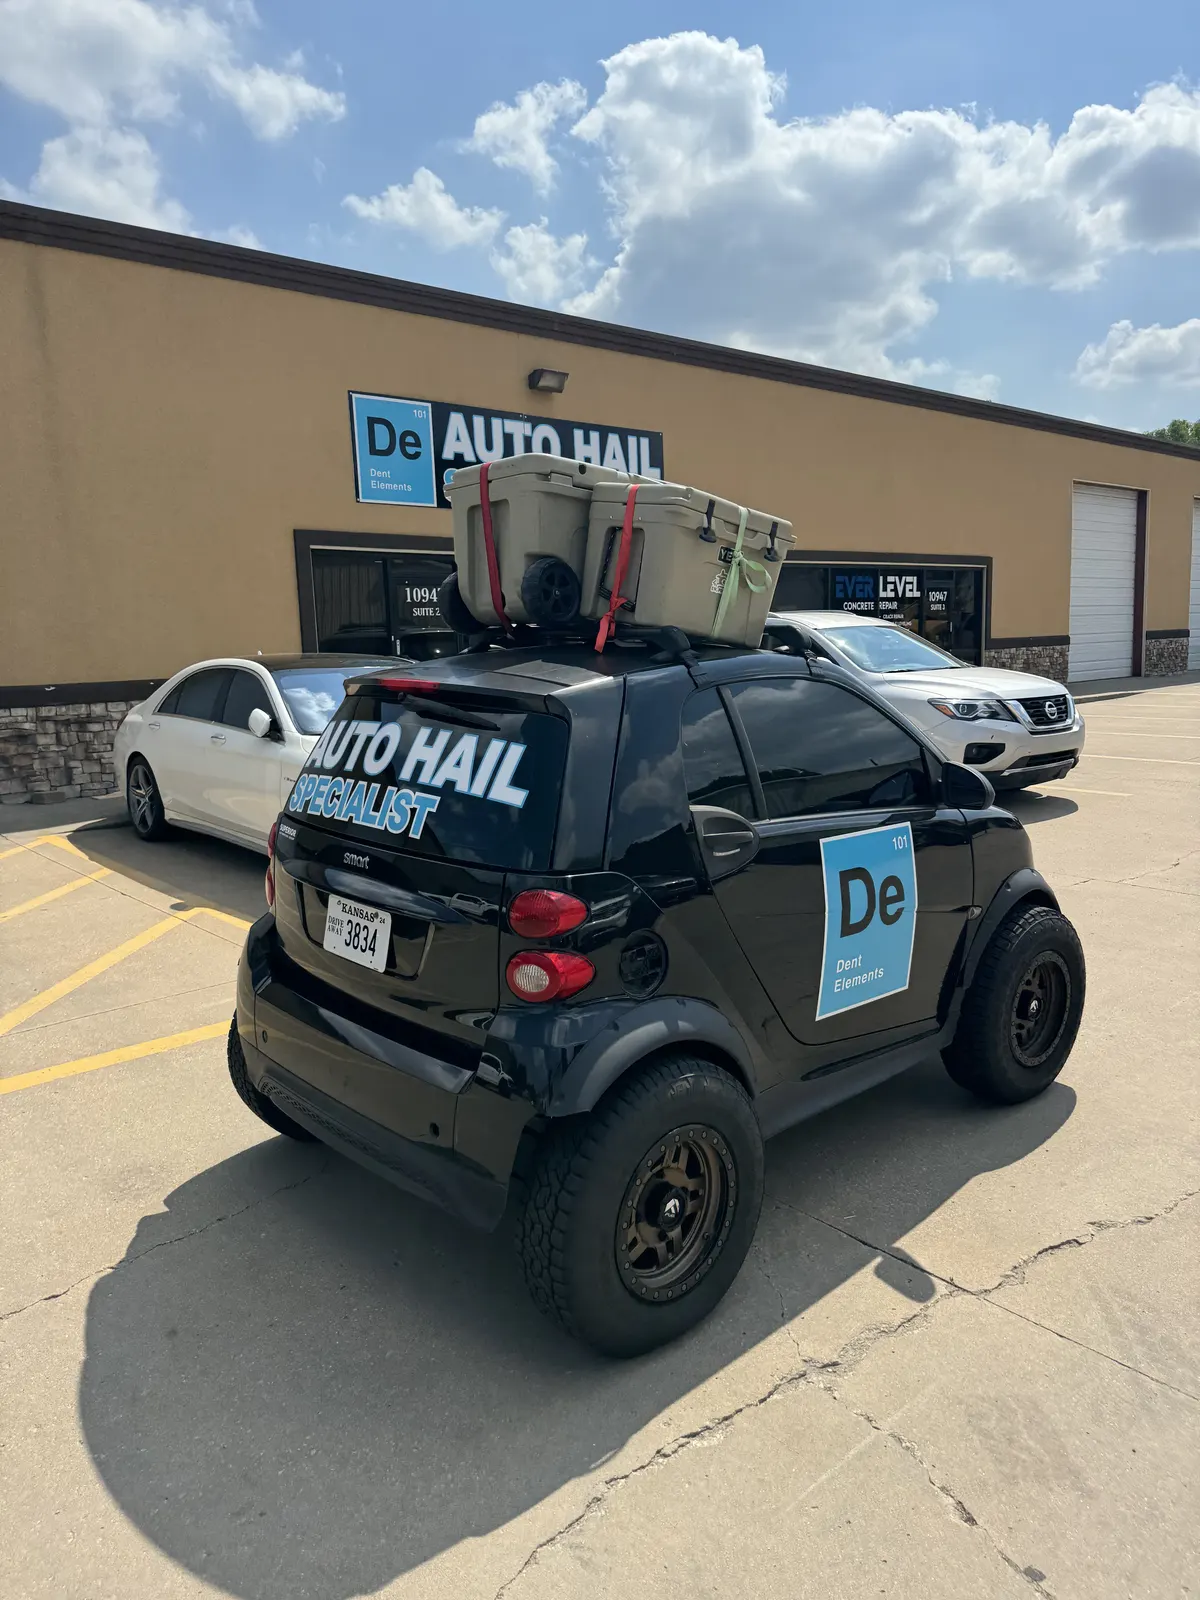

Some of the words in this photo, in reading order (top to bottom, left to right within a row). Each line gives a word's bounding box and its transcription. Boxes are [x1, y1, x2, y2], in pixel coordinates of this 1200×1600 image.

[413, 409, 427, 419] 101
[367, 416, 422, 460] De
[442, 412, 561, 463] AUTO
[573, 428, 661, 480] HAIL
[370, 468, 391, 479] Dent
[371, 481, 412, 492] Elements
[405, 588, 441, 602] 1094
[835, 576, 874, 597] EVER
[879, 575, 920, 597] LEVEL
[843, 602, 874, 611] CONCRETE
[879, 601, 898, 610] REPAIR
[928, 592, 948, 602] 10947
[413, 607, 435, 616] SUITE
[435, 607, 441, 616] 2
[304, 719, 402, 777] AUTO
[398, 726, 530, 809] HAIL
[289, 773, 441, 840] SPECIALIST
[892, 835, 908, 850] 101
[343, 852, 370, 870] smart
[839, 867, 905, 939] De
[341, 903, 374, 922] KANSAS
[327, 924, 343, 936] AWAY
[328, 916, 344, 928] DRIVE
[344, 919, 377, 956] 3834
[836, 954, 863, 974] Dent
[834, 966, 884, 993] Elements
